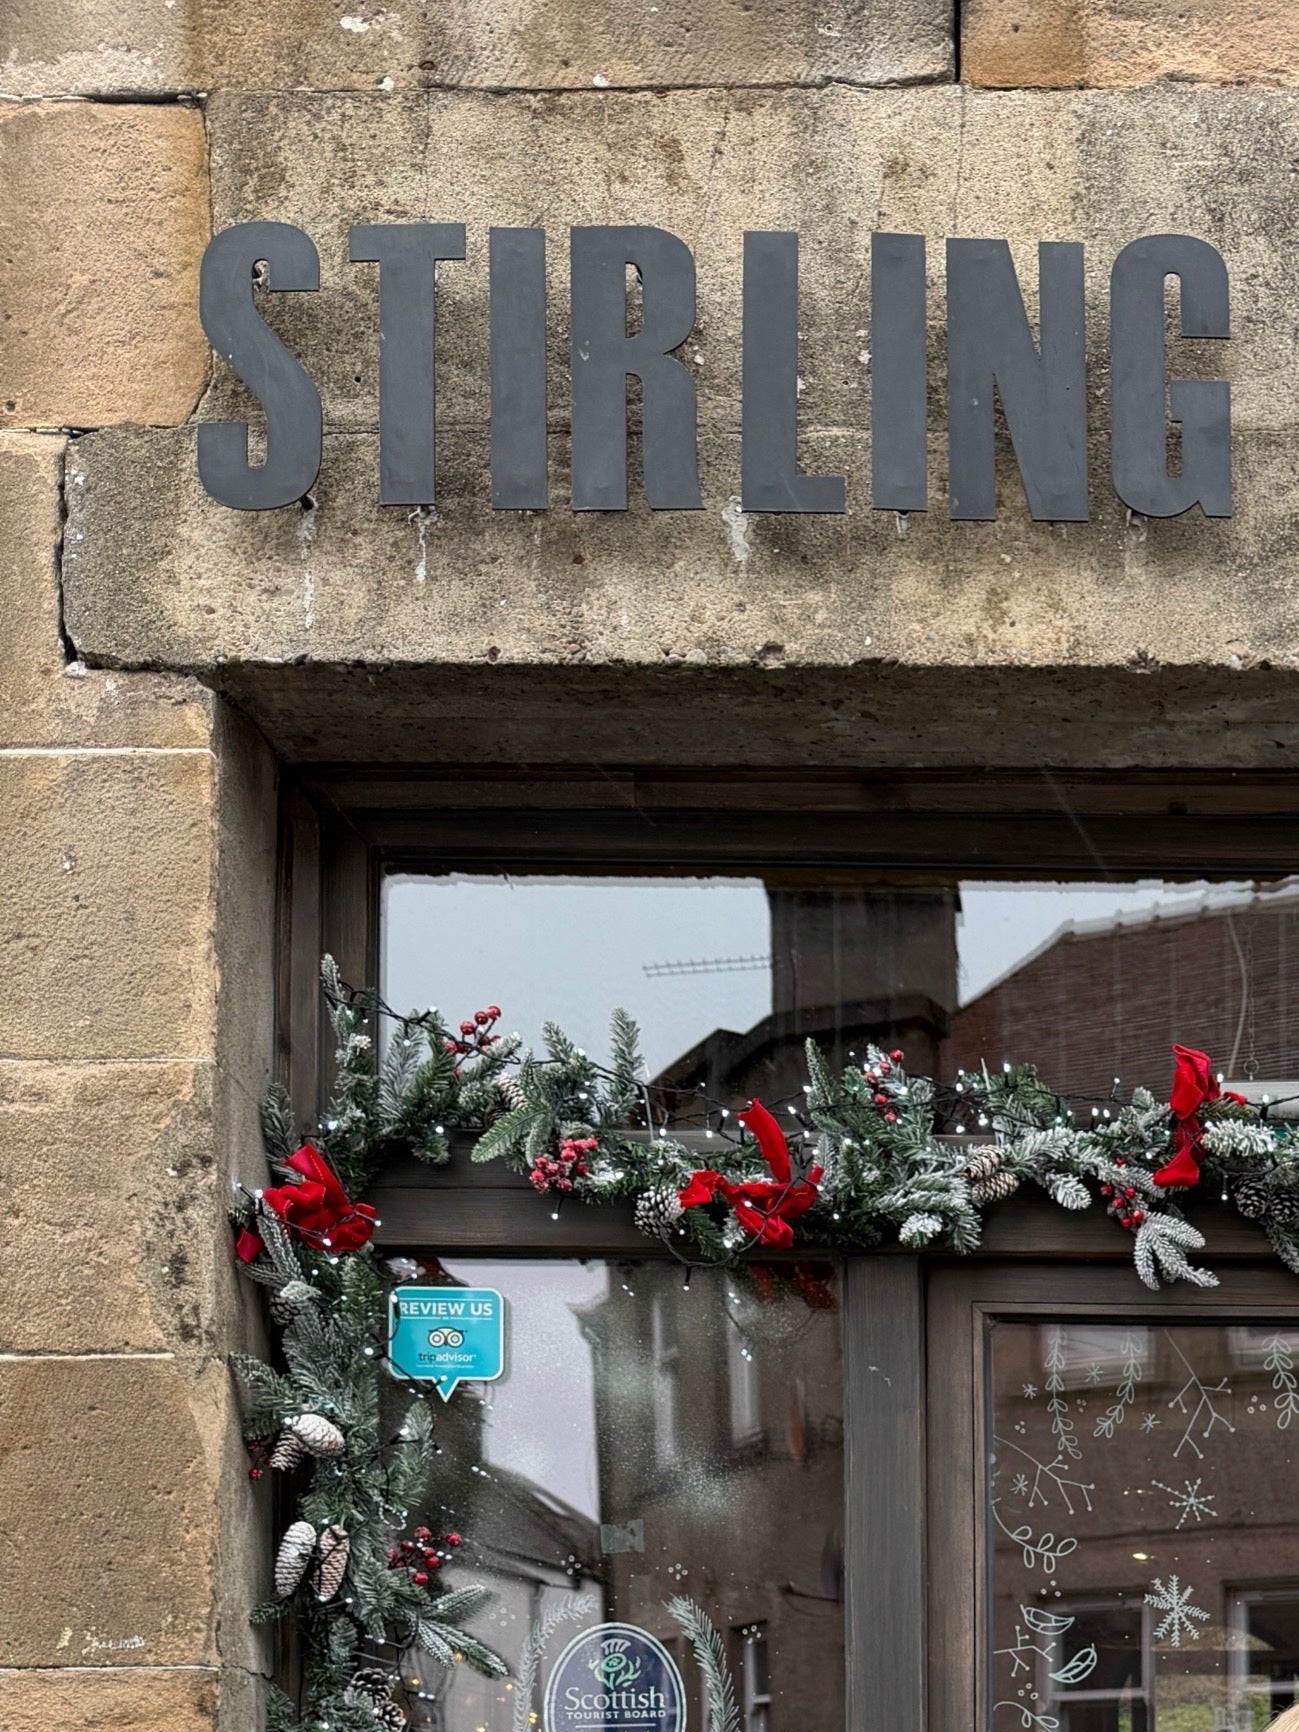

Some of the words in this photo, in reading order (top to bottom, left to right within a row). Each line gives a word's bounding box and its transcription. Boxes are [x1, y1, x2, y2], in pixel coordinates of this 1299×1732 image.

[198, 221, 1233, 522] STIRLING
[399, 1302, 464, 1316] REVIEW
[470, 1302, 493, 1316] US
[418, 1351, 474, 1364] tripadvisor
[564, 1686, 666, 1711] Scottish
[566, 1711, 619, 1720] TOURIST
[624, 1709, 667, 1719] BOARD
